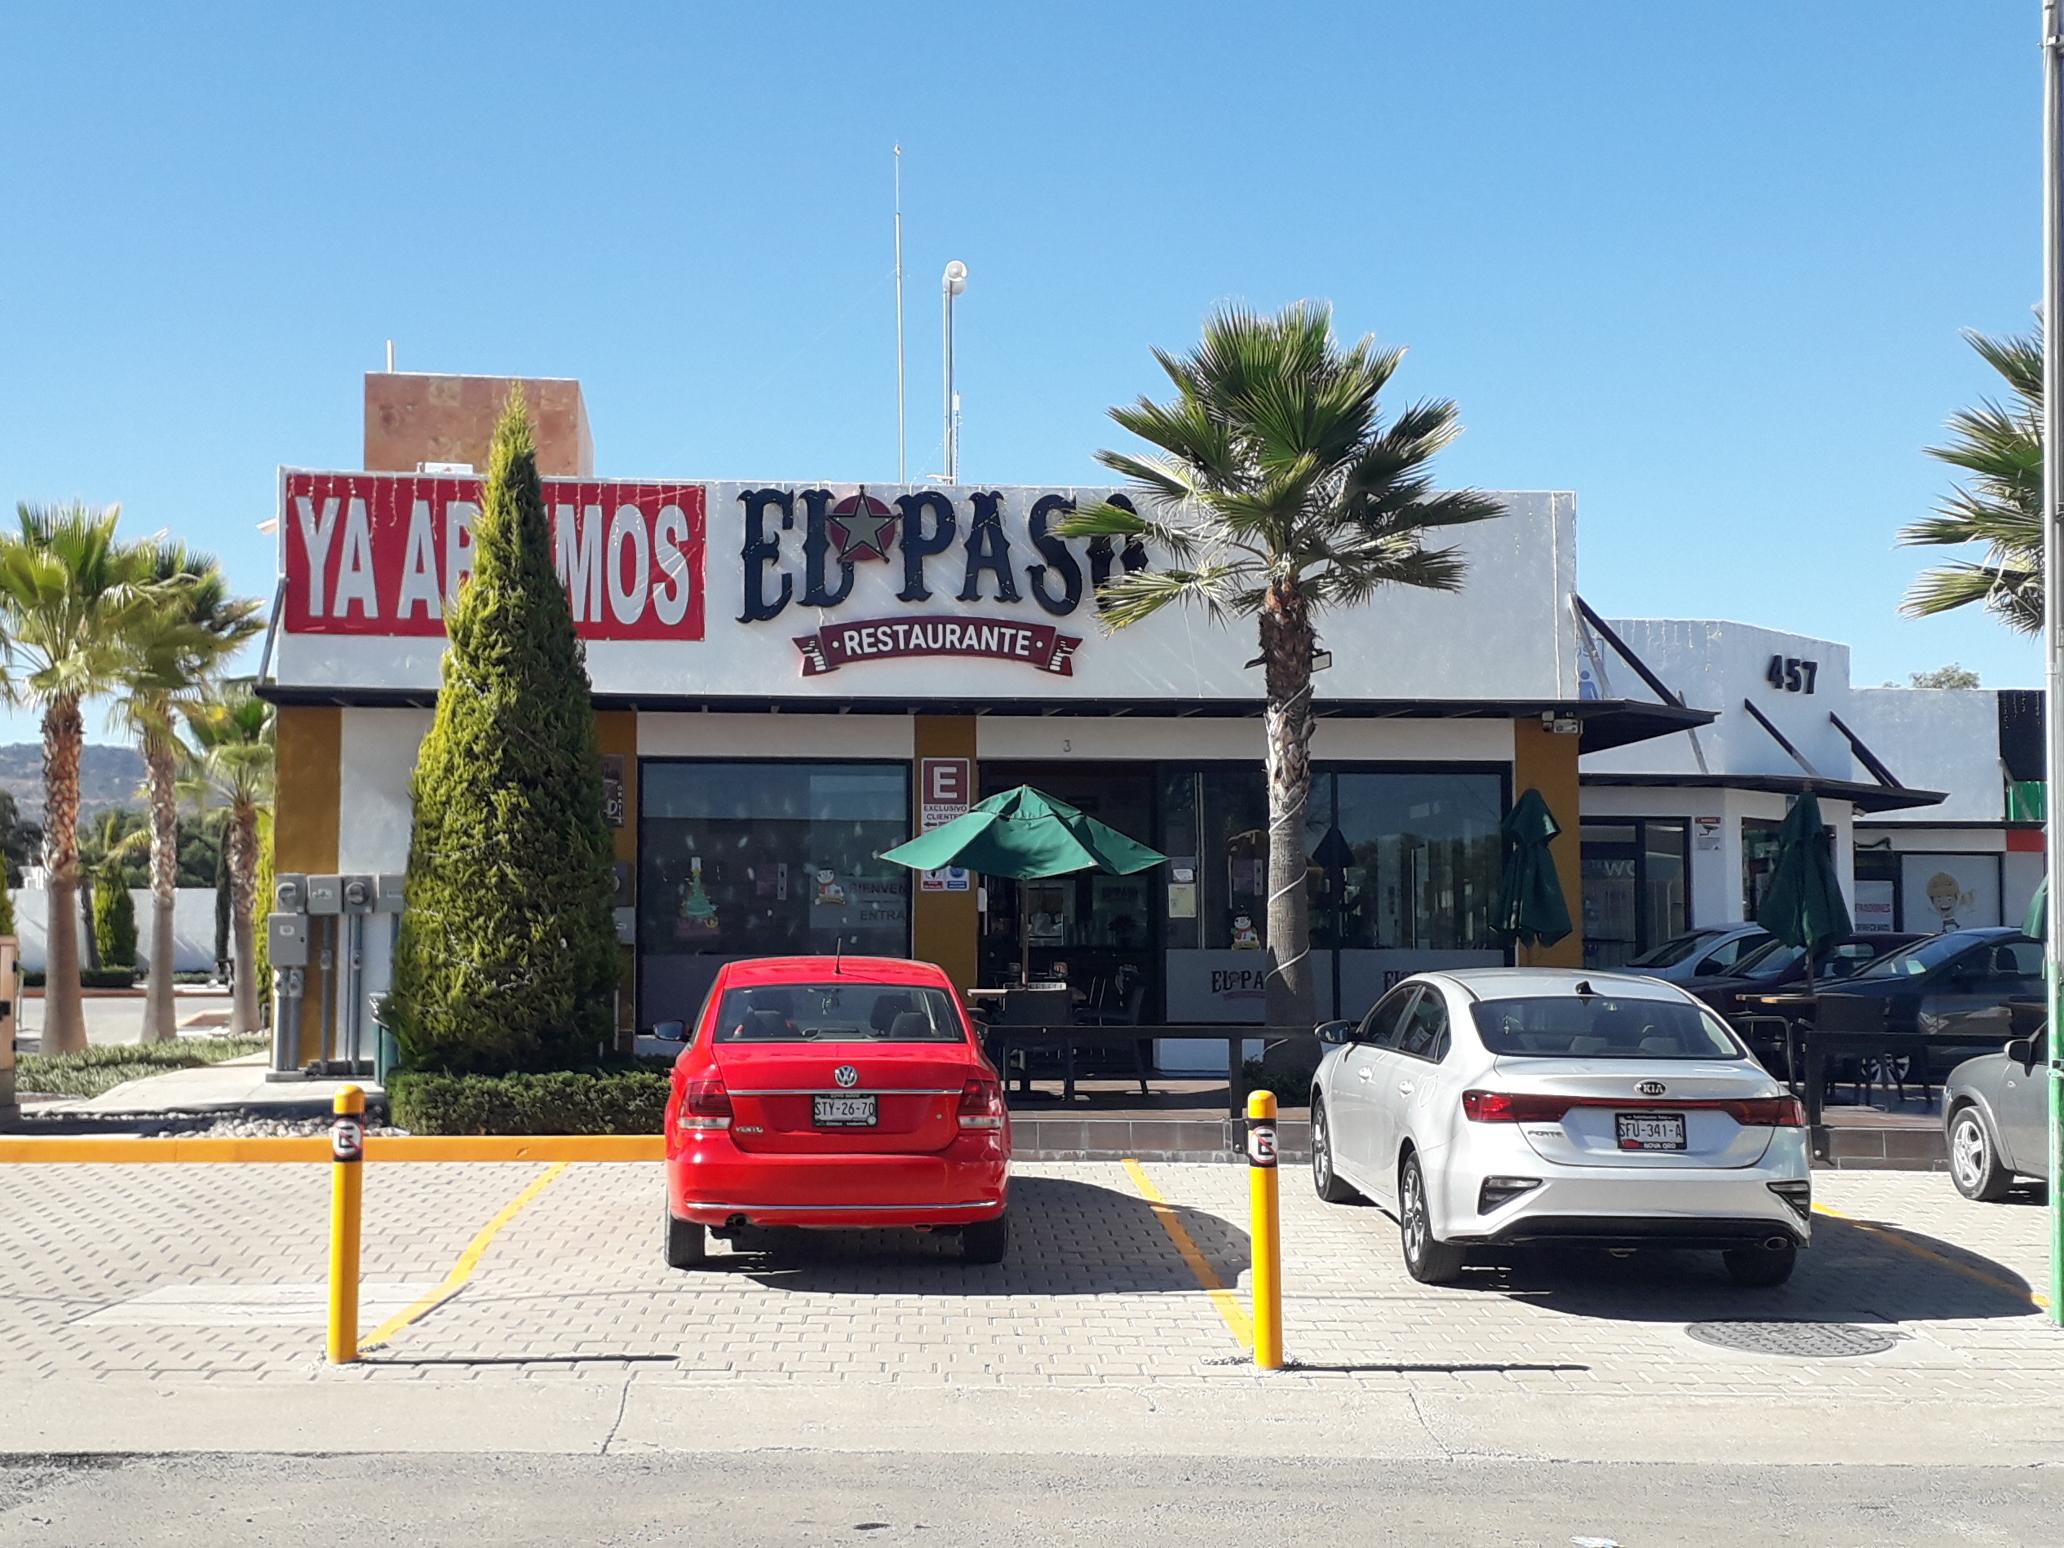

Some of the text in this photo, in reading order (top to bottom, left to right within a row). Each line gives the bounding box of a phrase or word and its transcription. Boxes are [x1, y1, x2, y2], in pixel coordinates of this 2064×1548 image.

[295, 496, 690, 626] YA ABMOS
[735, 488, 854, 624] EL
[843, 624, 1033, 656] RESTAURANTE
[1766, 654, 1818, 695] 457
[1063, 739, 1072, 753] 3
[933, 766, 957, 799] E
[1643, 1084, 1663, 1093] KIA
[814, 1102, 875, 1116] STY-26-70
[1617, 1122, 1682, 1138] SFU-341-A
[1258, 1133, 1273, 1156] E
